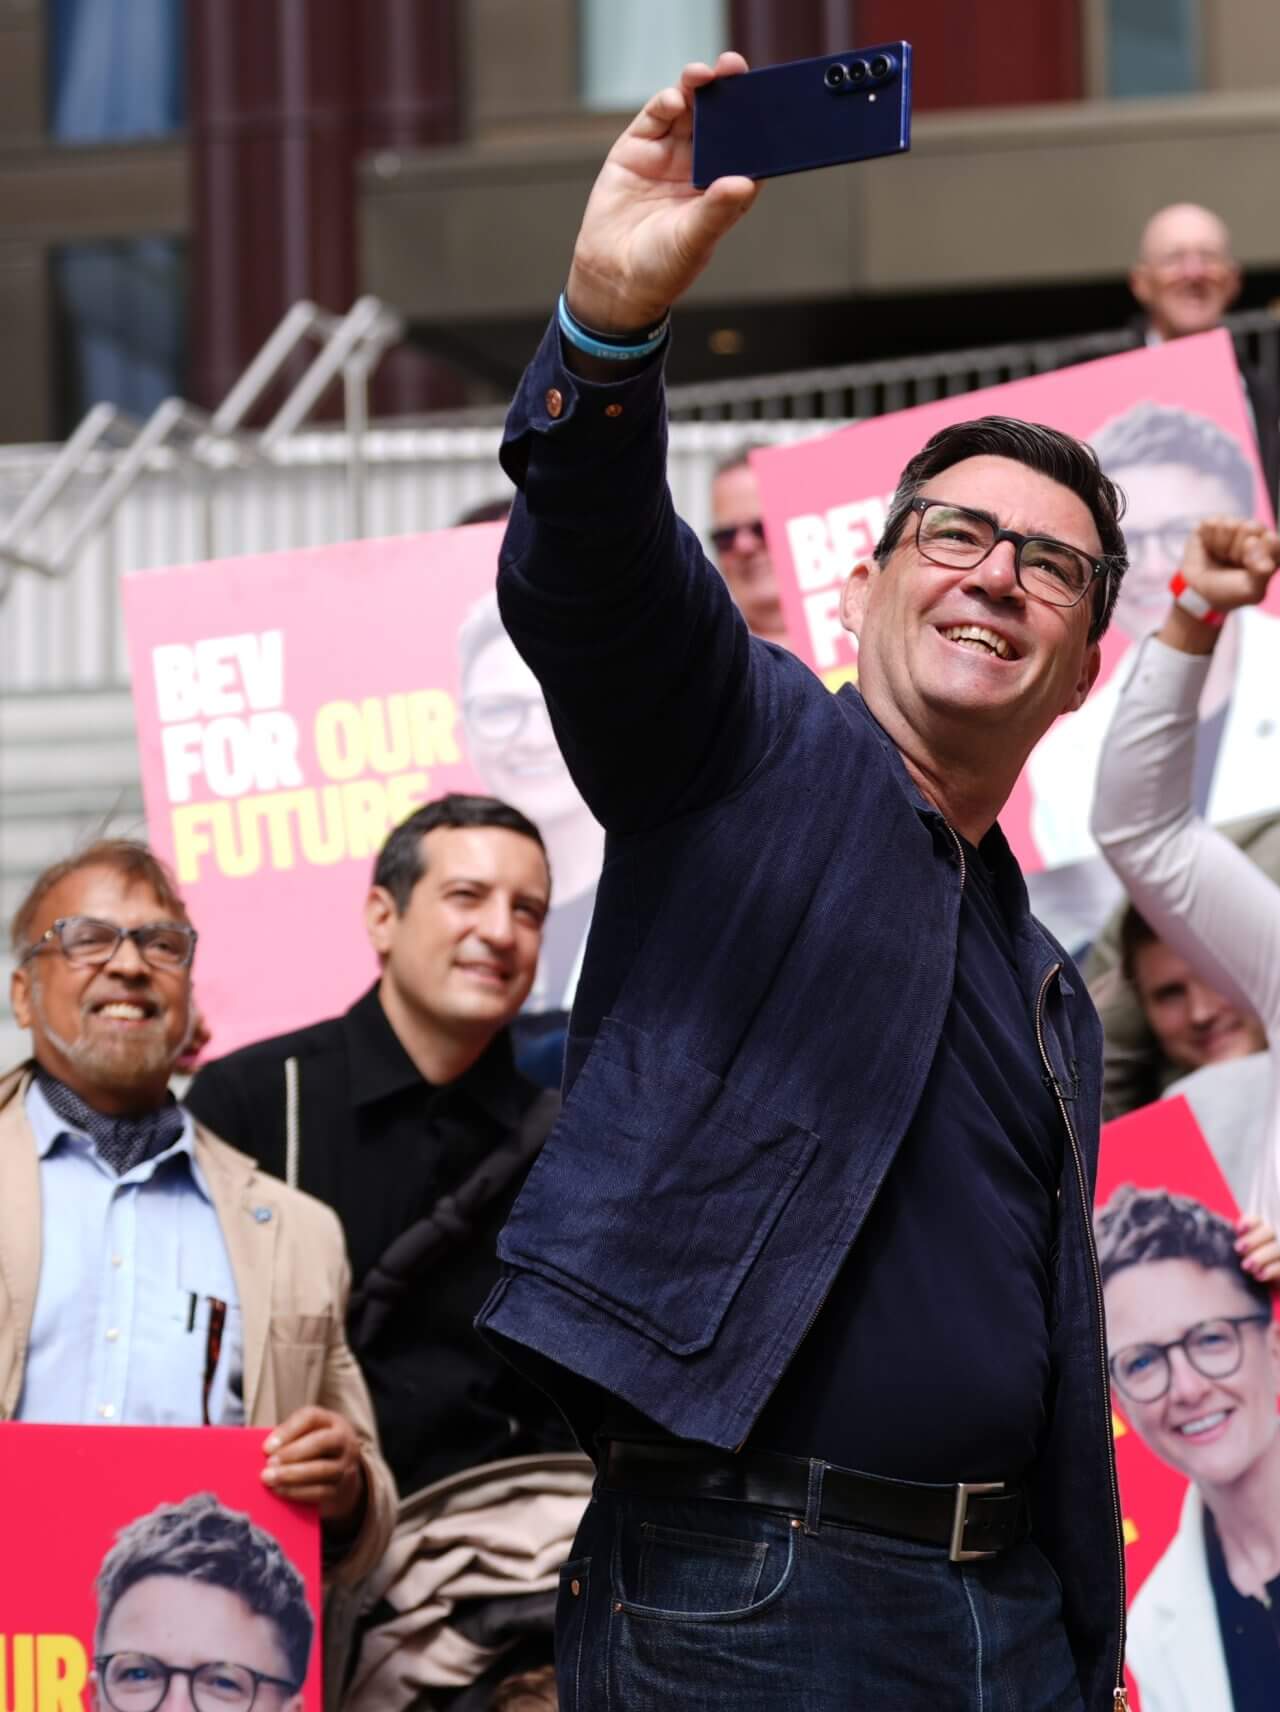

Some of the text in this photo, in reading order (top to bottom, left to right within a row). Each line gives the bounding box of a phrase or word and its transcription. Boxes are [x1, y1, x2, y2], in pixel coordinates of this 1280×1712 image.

[152, 629, 283, 723] BEV
[161, 687, 460, 803] FOR OUR
[0, 1633, 88, 1712] UR
